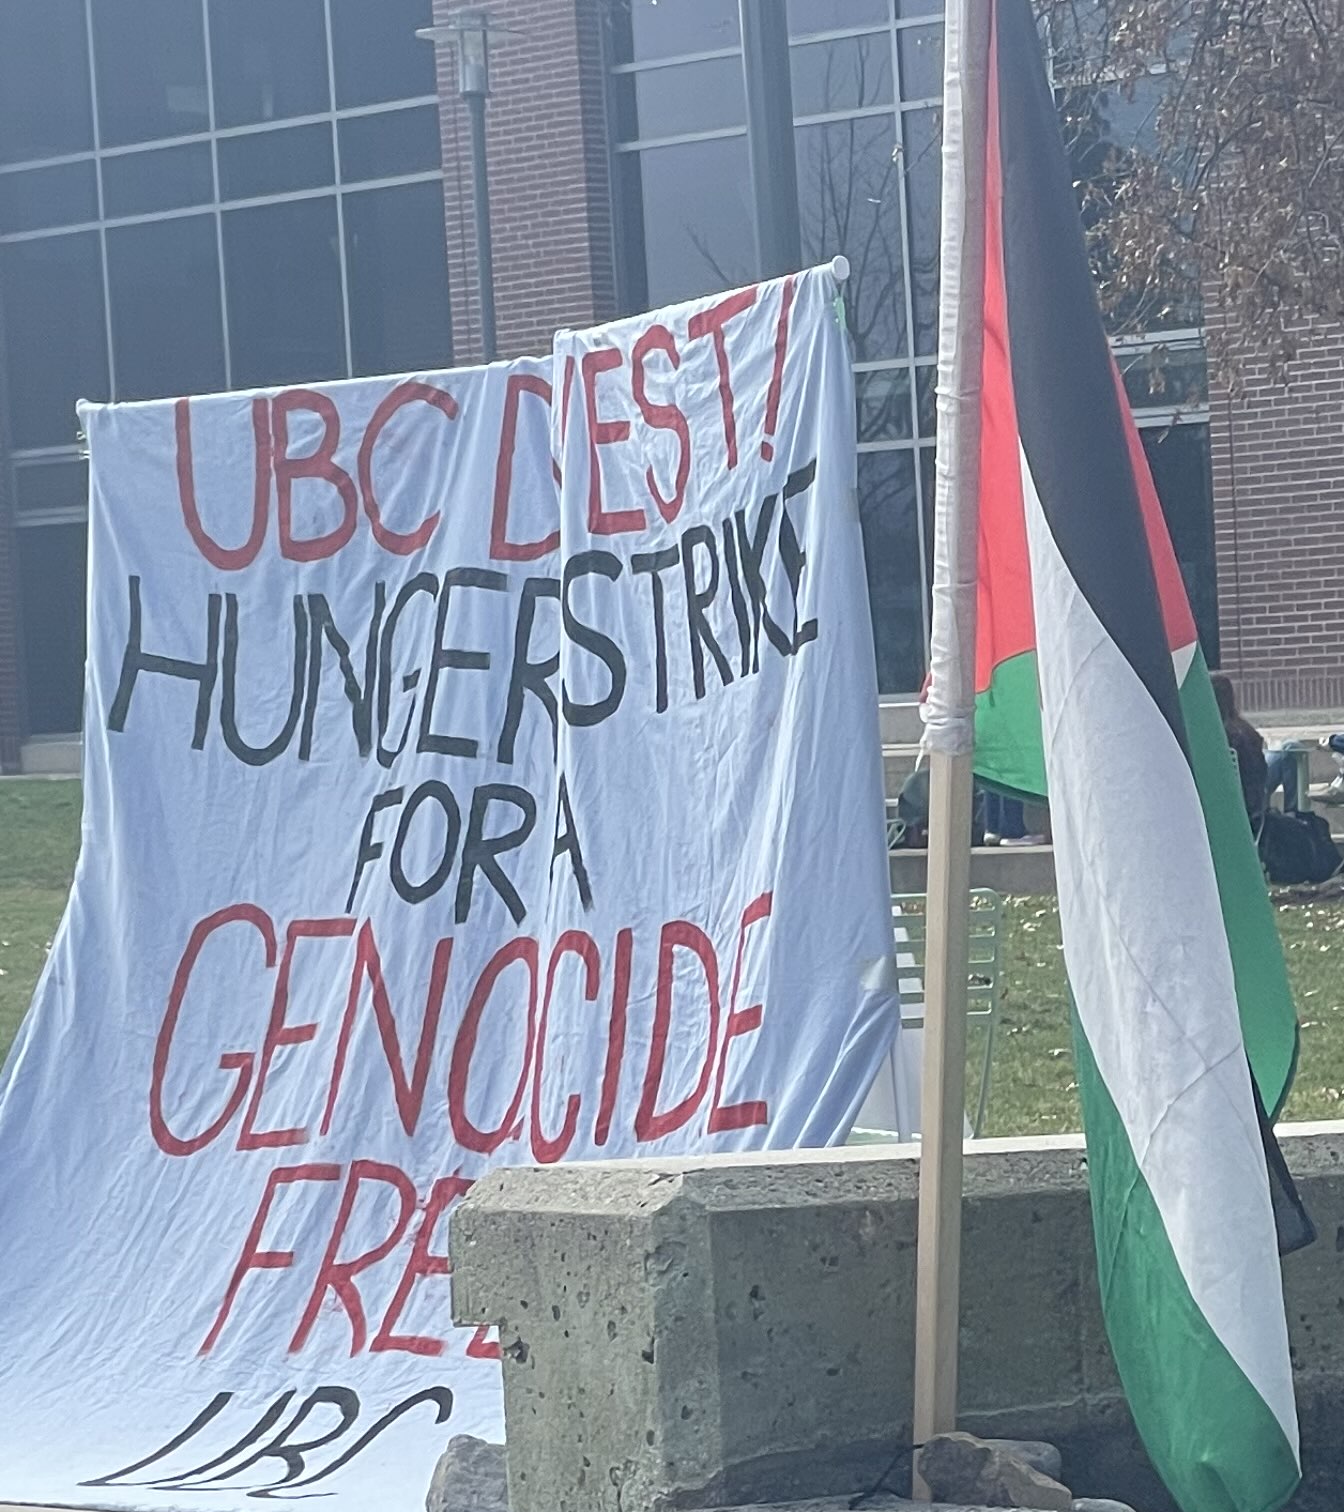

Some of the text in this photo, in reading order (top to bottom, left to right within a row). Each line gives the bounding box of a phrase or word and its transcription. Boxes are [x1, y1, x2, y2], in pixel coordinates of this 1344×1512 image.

[175, 380, 458, 571] UBC
[108, 567, 560, 767] HUNGER
[345, 772, 593, 924] FOR A
[149, 891, 773, 1164] GENOCIDE
